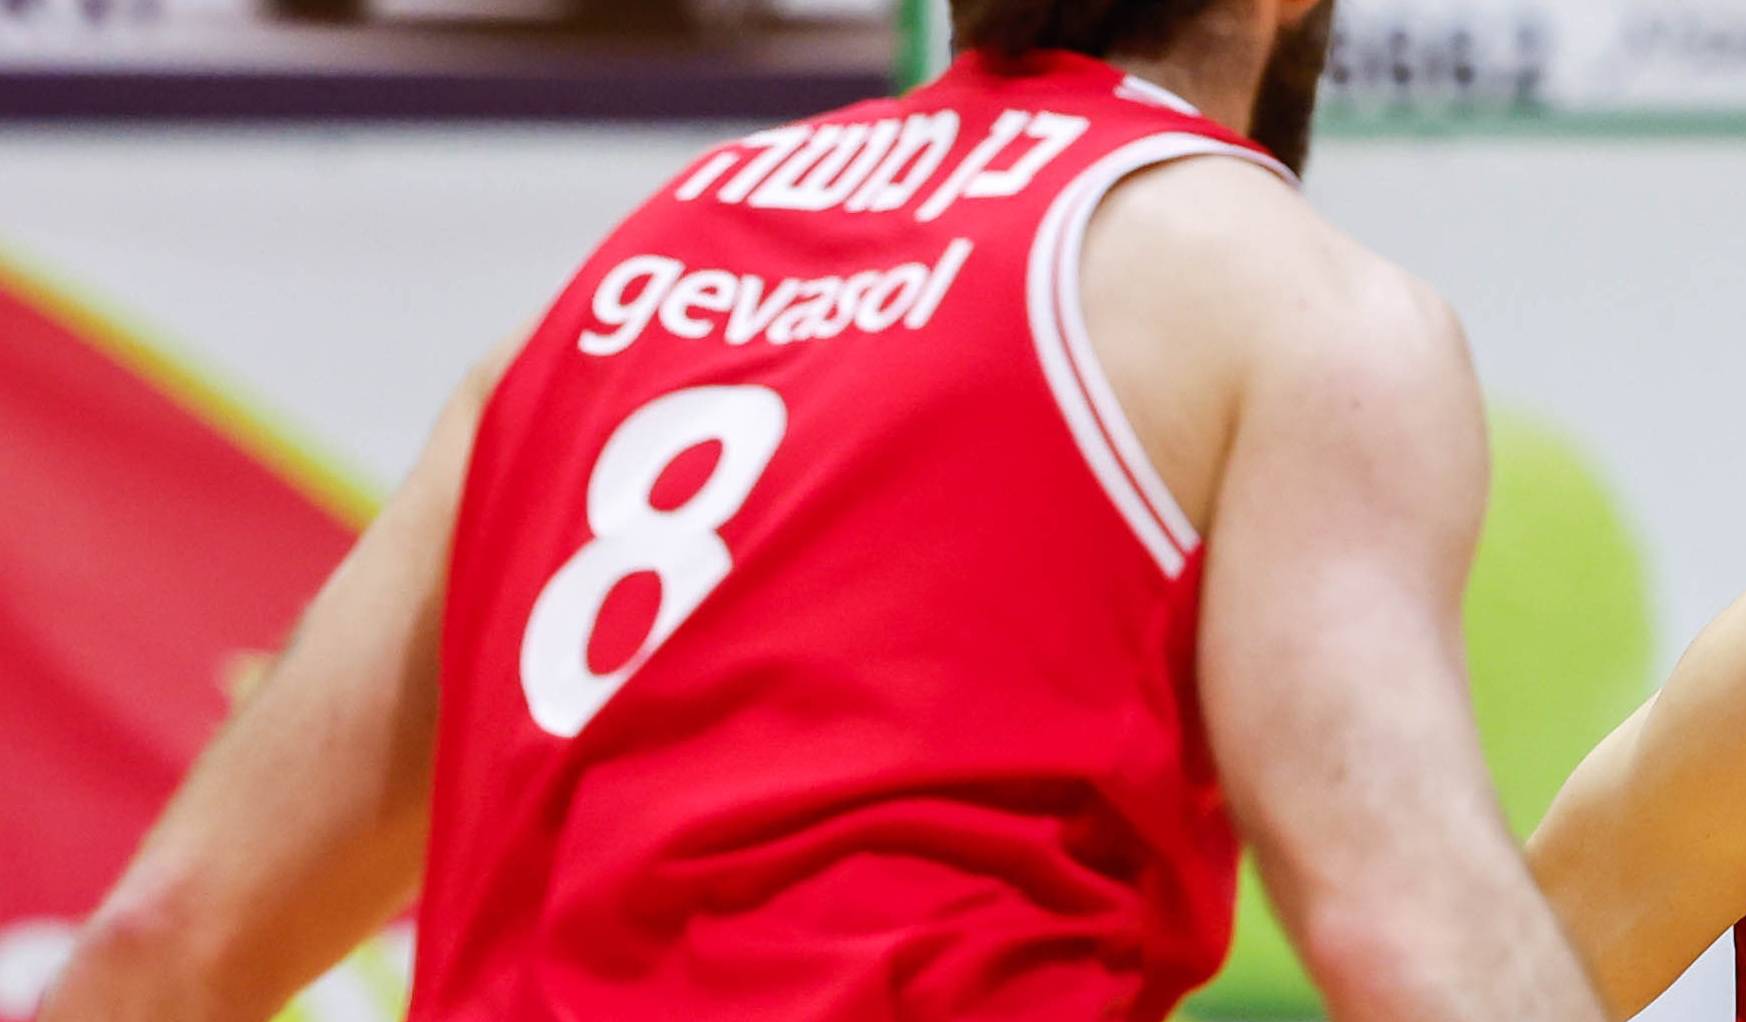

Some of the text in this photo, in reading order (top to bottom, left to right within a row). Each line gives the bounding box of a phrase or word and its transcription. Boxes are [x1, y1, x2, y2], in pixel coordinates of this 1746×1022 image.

[675, 108, 1090, 223] בן משה
[577, 237, 975, 357] gevasol
[519, 384, 788, 738] 8
